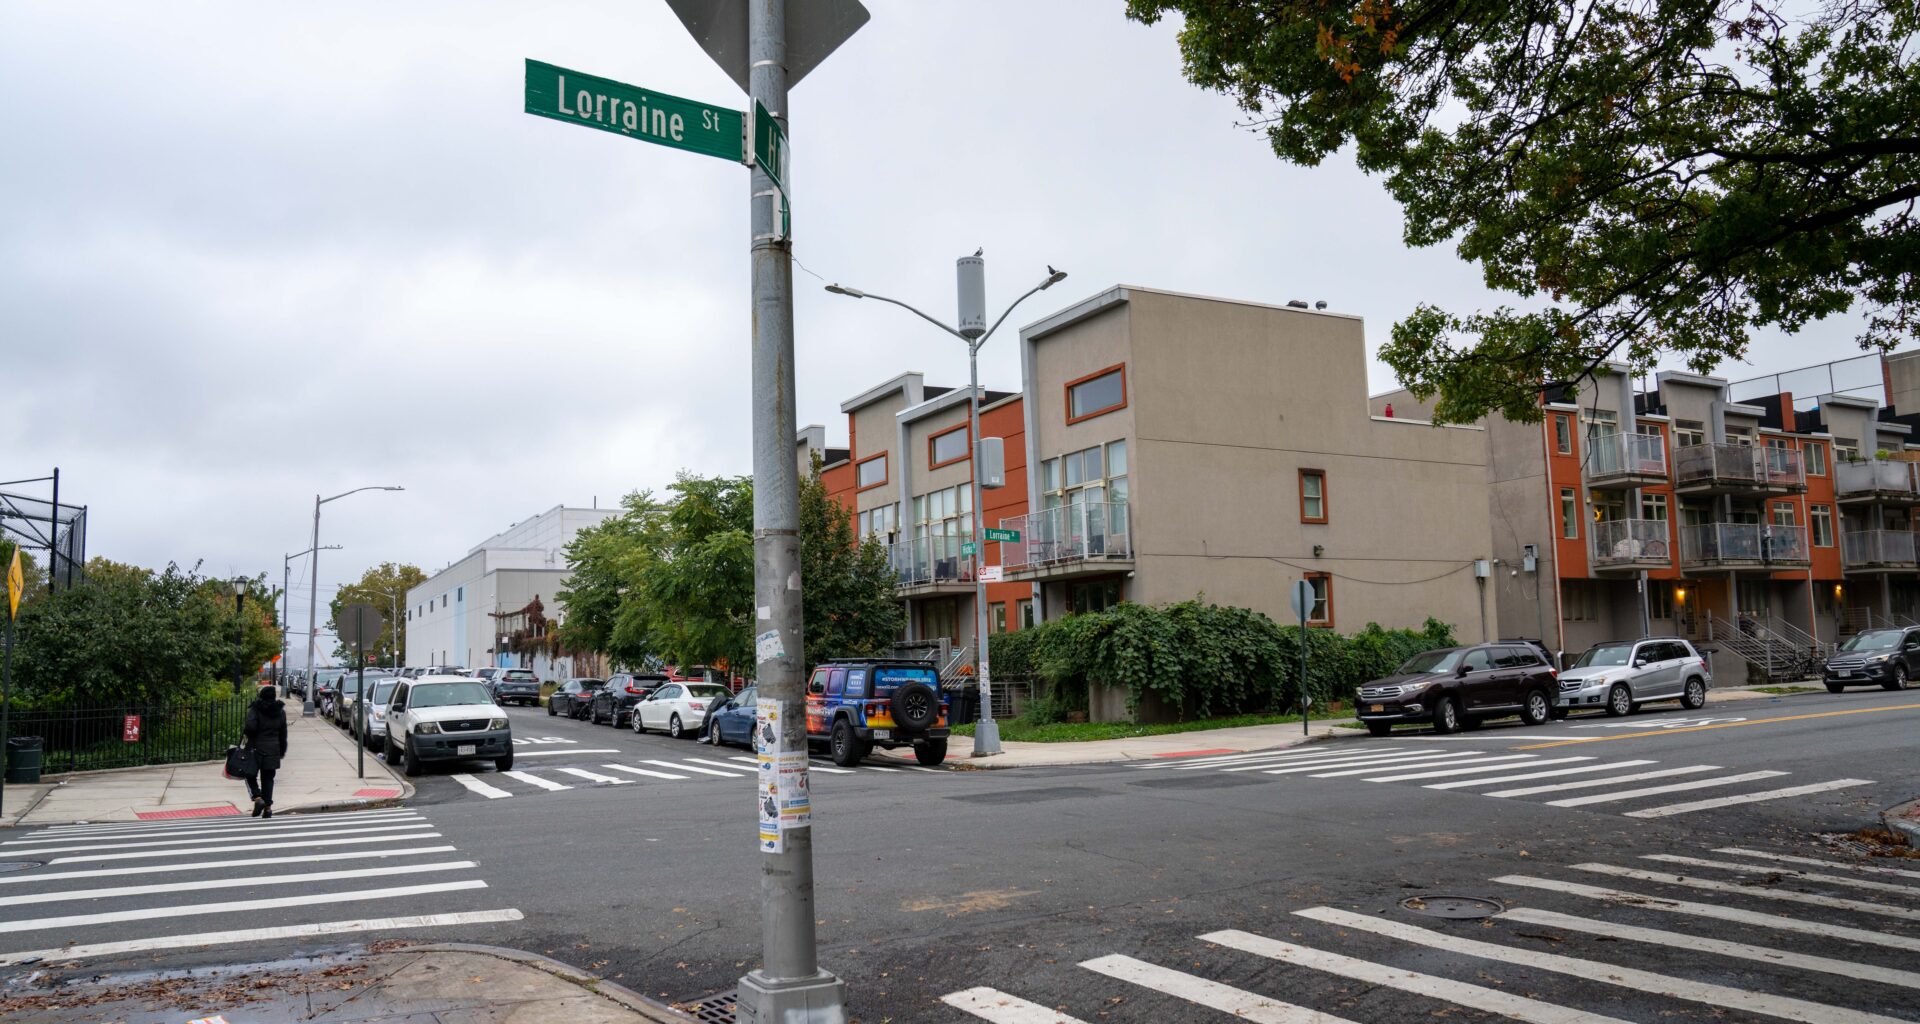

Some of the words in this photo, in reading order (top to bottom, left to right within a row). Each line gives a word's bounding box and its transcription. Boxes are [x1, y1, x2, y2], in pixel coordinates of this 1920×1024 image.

[558, 75, 684, 142] Lorraine
[702, 109, 720, 133] St
[990, 530, 1010, 541] Lorraine
